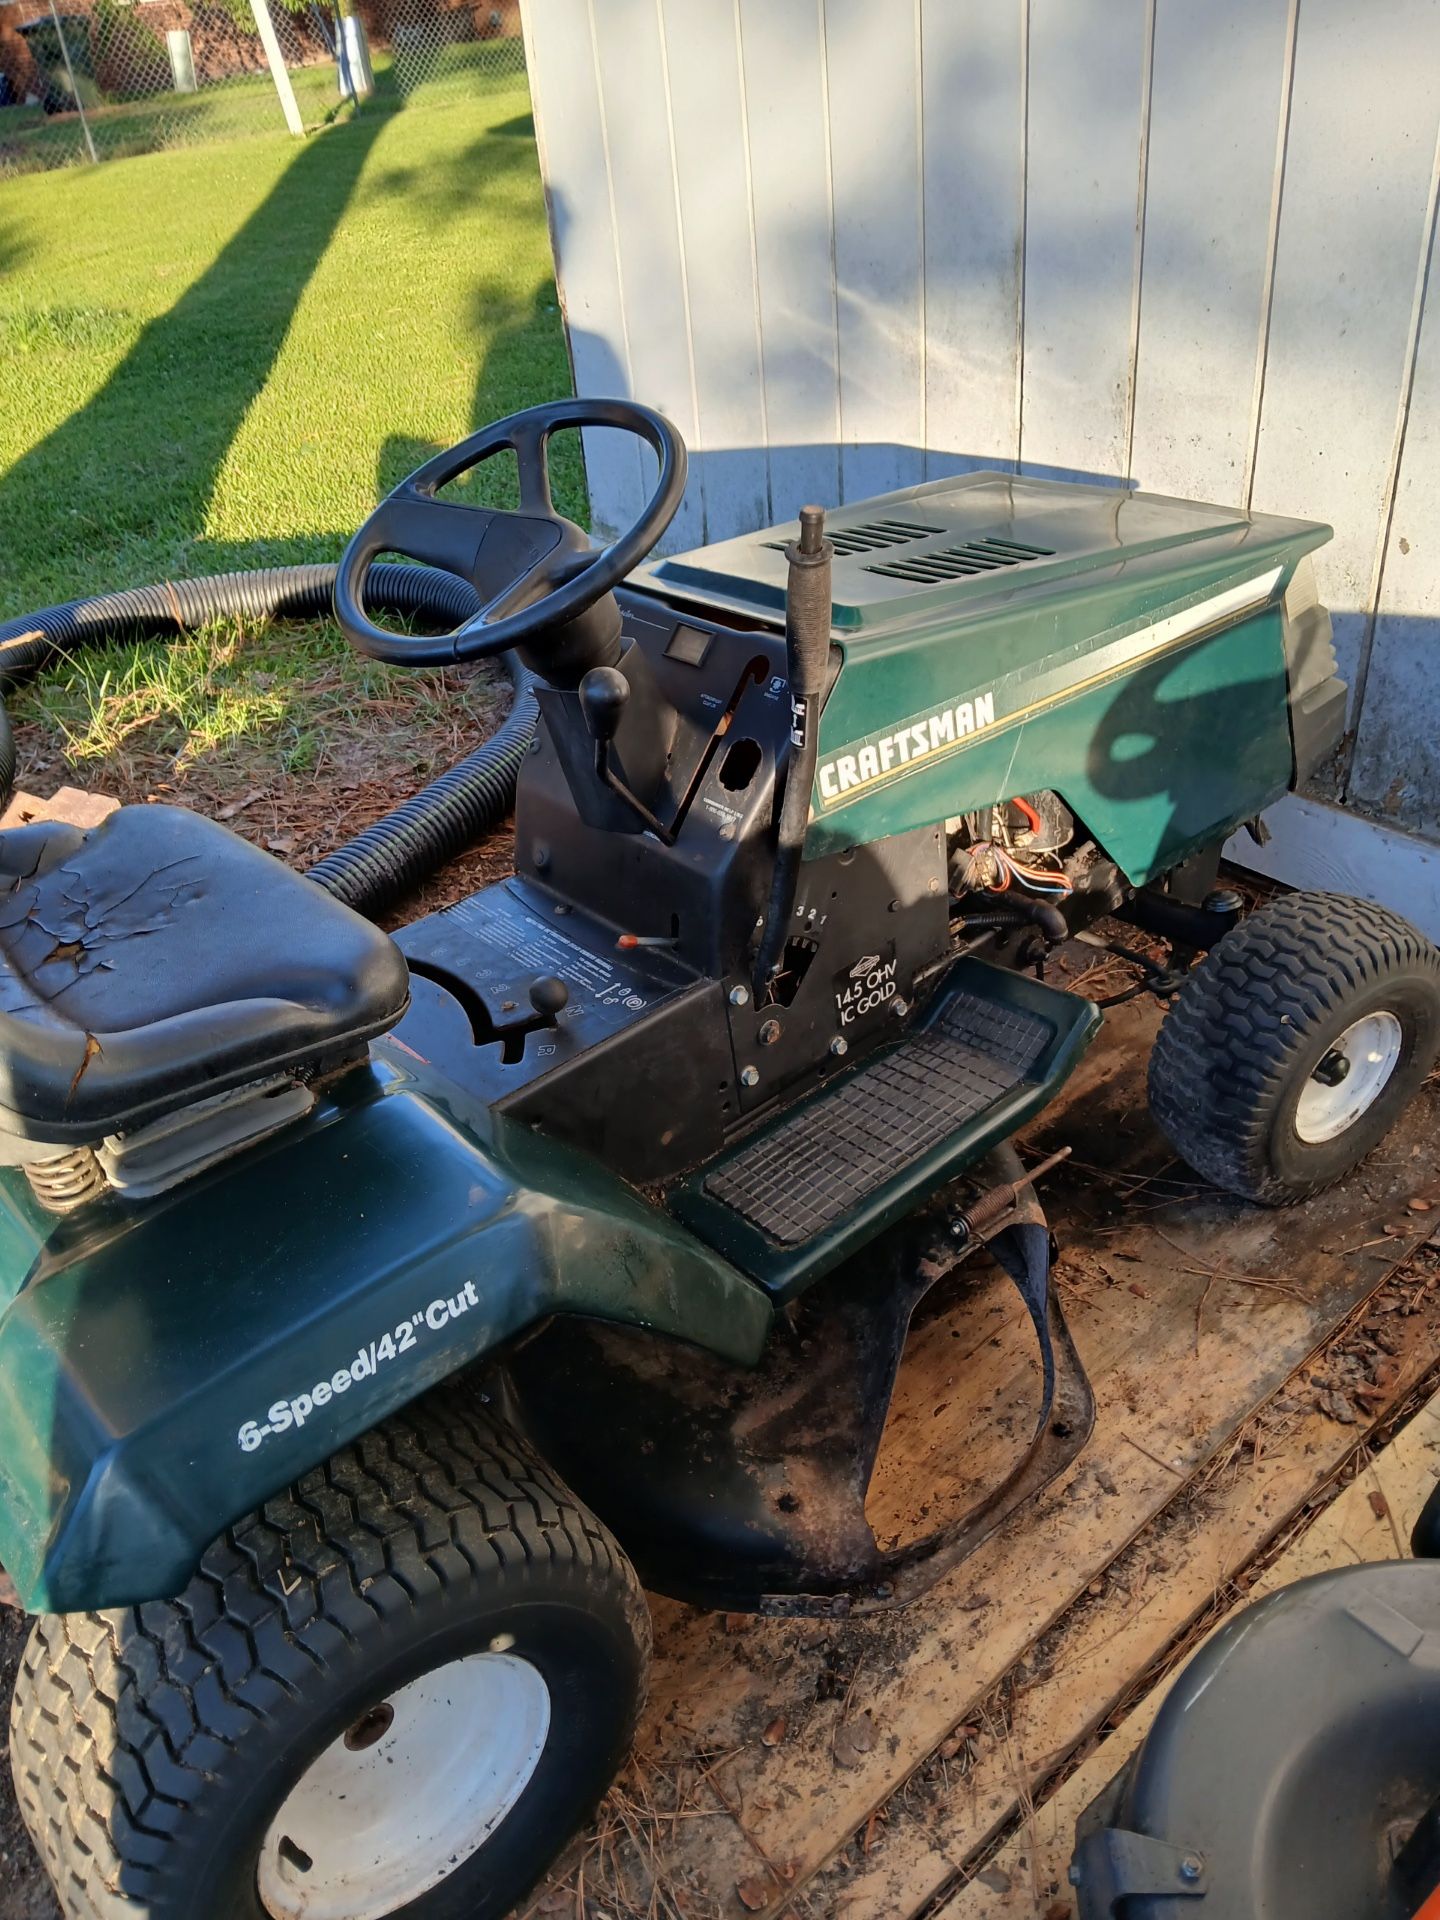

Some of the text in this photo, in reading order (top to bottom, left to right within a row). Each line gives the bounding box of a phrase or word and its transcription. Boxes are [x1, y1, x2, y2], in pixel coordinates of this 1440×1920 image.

[819, 691, 995, 799] CRAFTSMAN
[796, 905, 805, 917] 3
[807, 908, 817, 920] 2
[820, 915, 828, 925] 1
[836, 980, 863, 1009] 14.5
[866, 958, 897, 989] OHV
[564, 1004, 585, 1018] N
[840, 981, 897, 1027] IC GOLD
[537, 1044, 557, 1057] R
